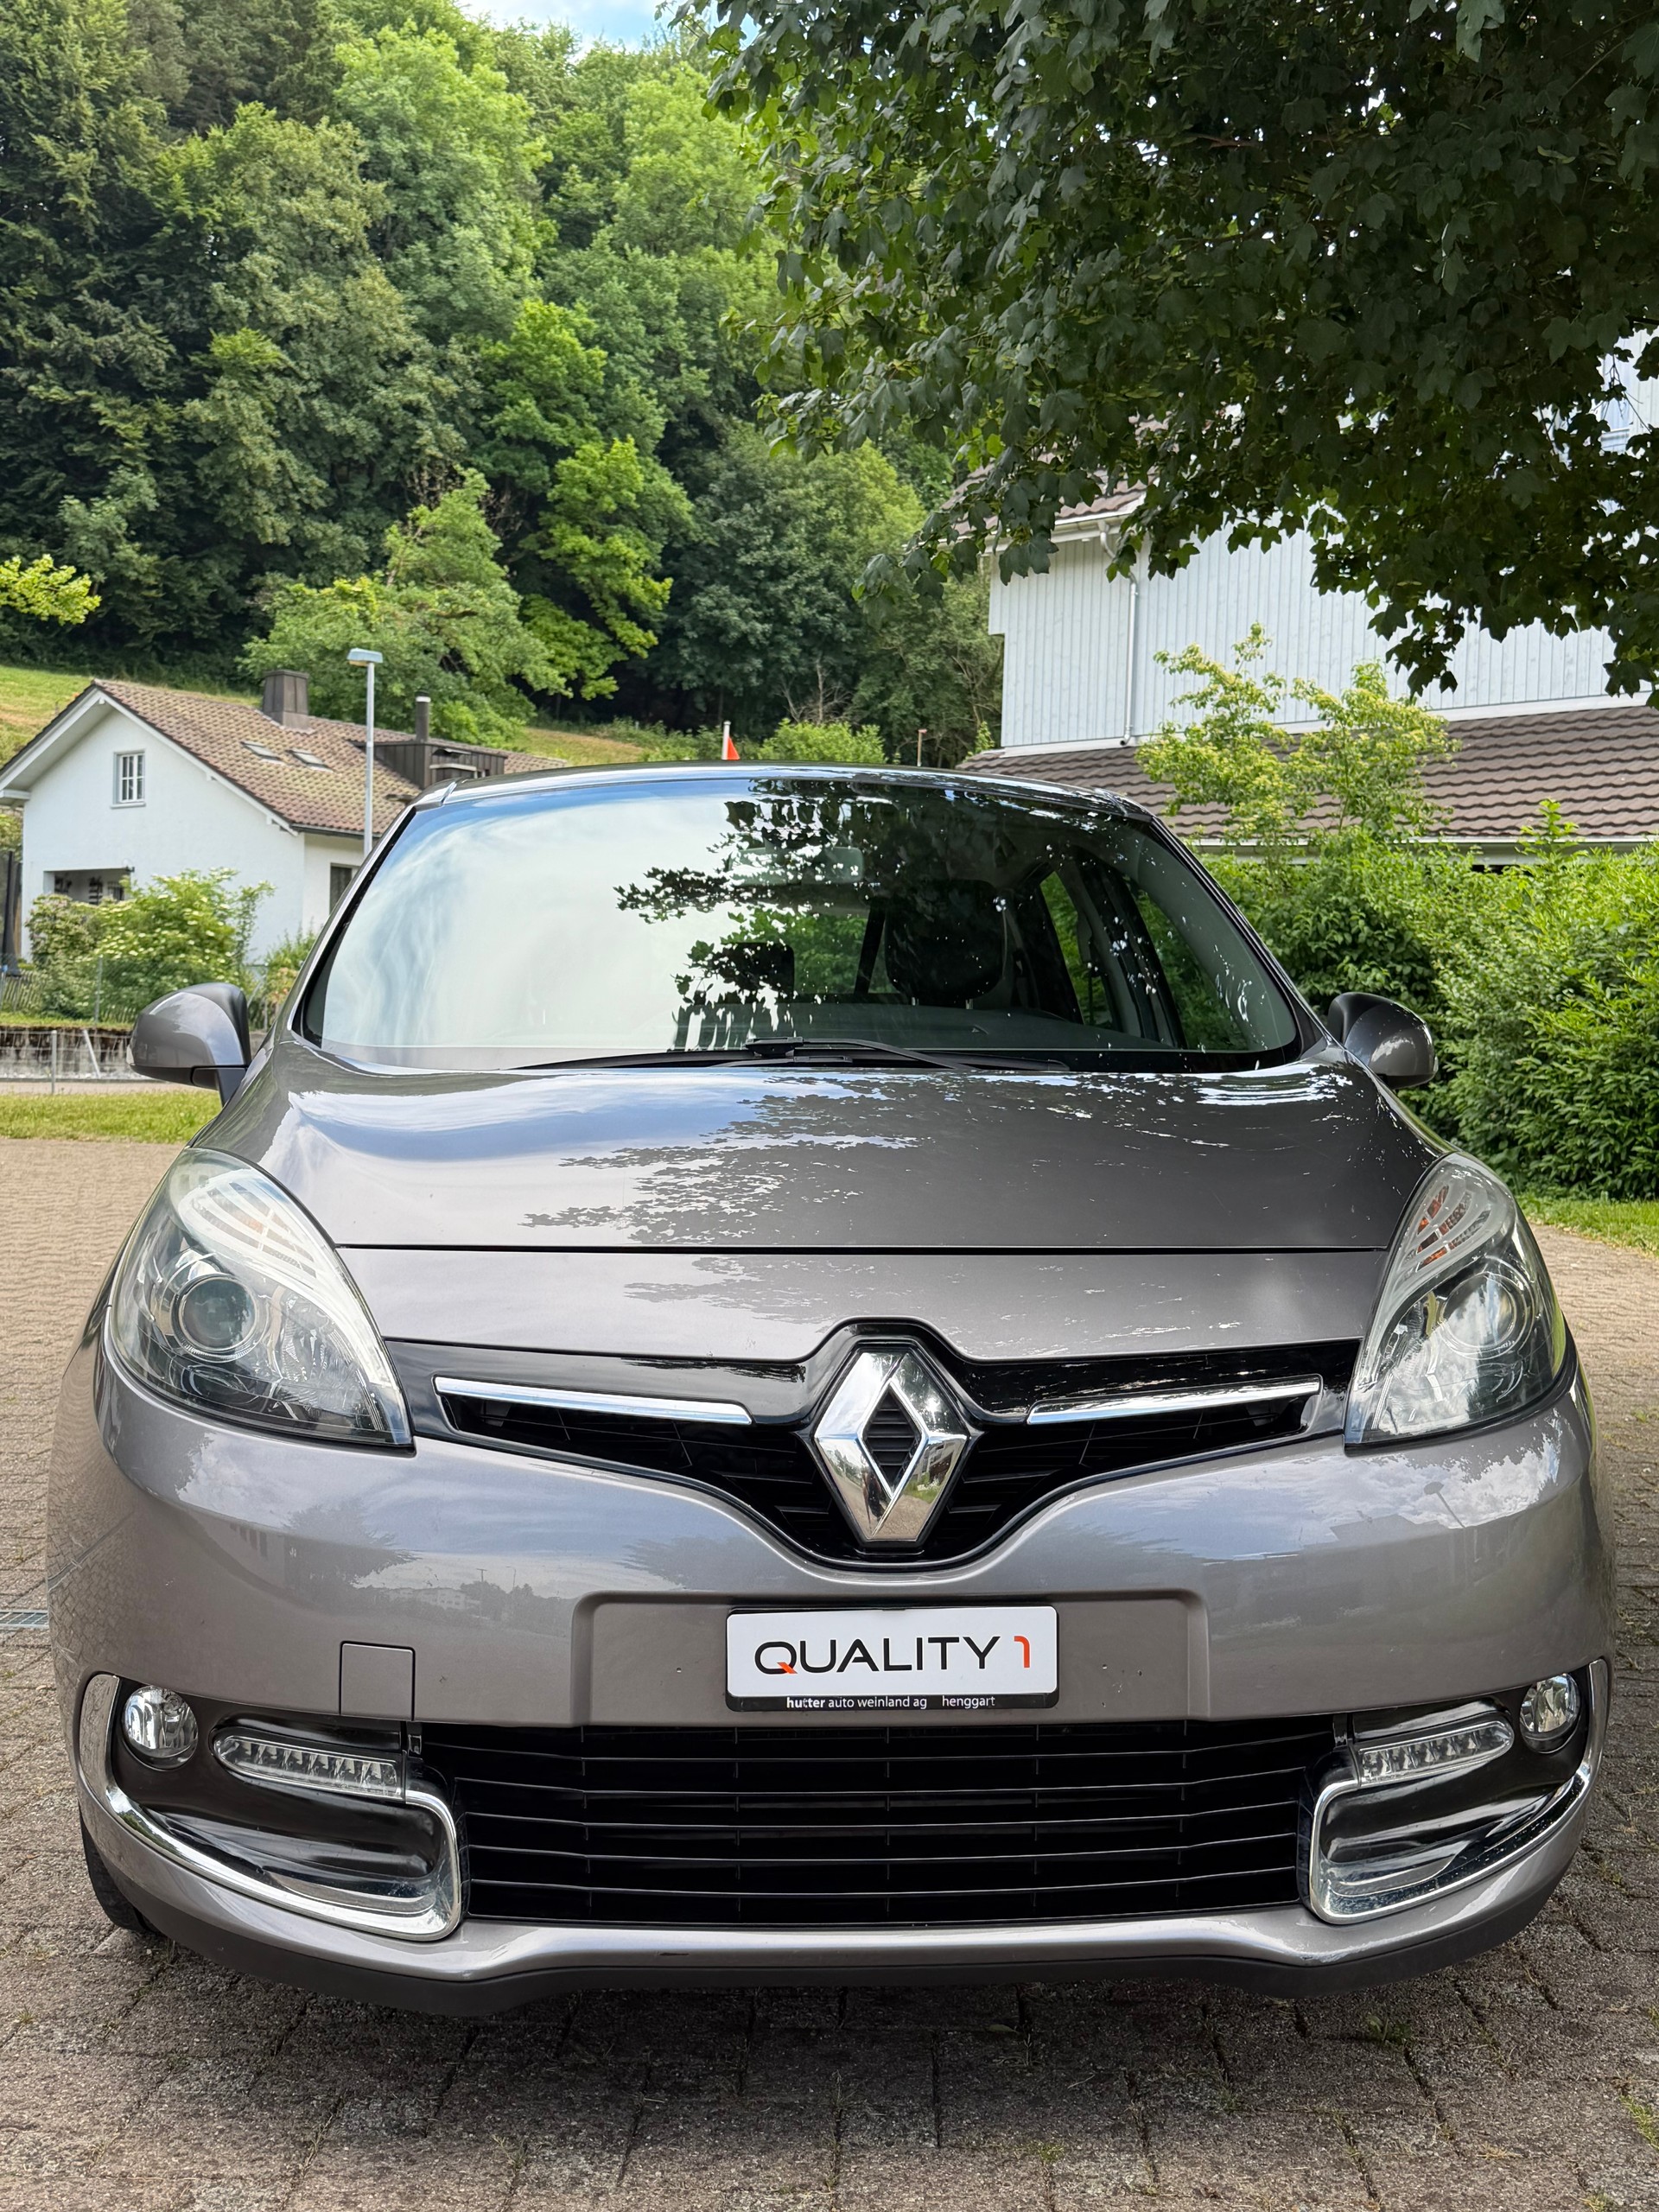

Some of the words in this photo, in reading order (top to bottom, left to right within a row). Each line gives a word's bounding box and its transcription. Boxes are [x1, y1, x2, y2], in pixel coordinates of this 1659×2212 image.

[786, 1697, 825, 1708] hutter
[828, 1698, 854, 1708] auto
[857, 1696, 909, 1708] weinland
[912, 1699, 927, 1709] ag
[942, 1695, 995, 1708] henggart
